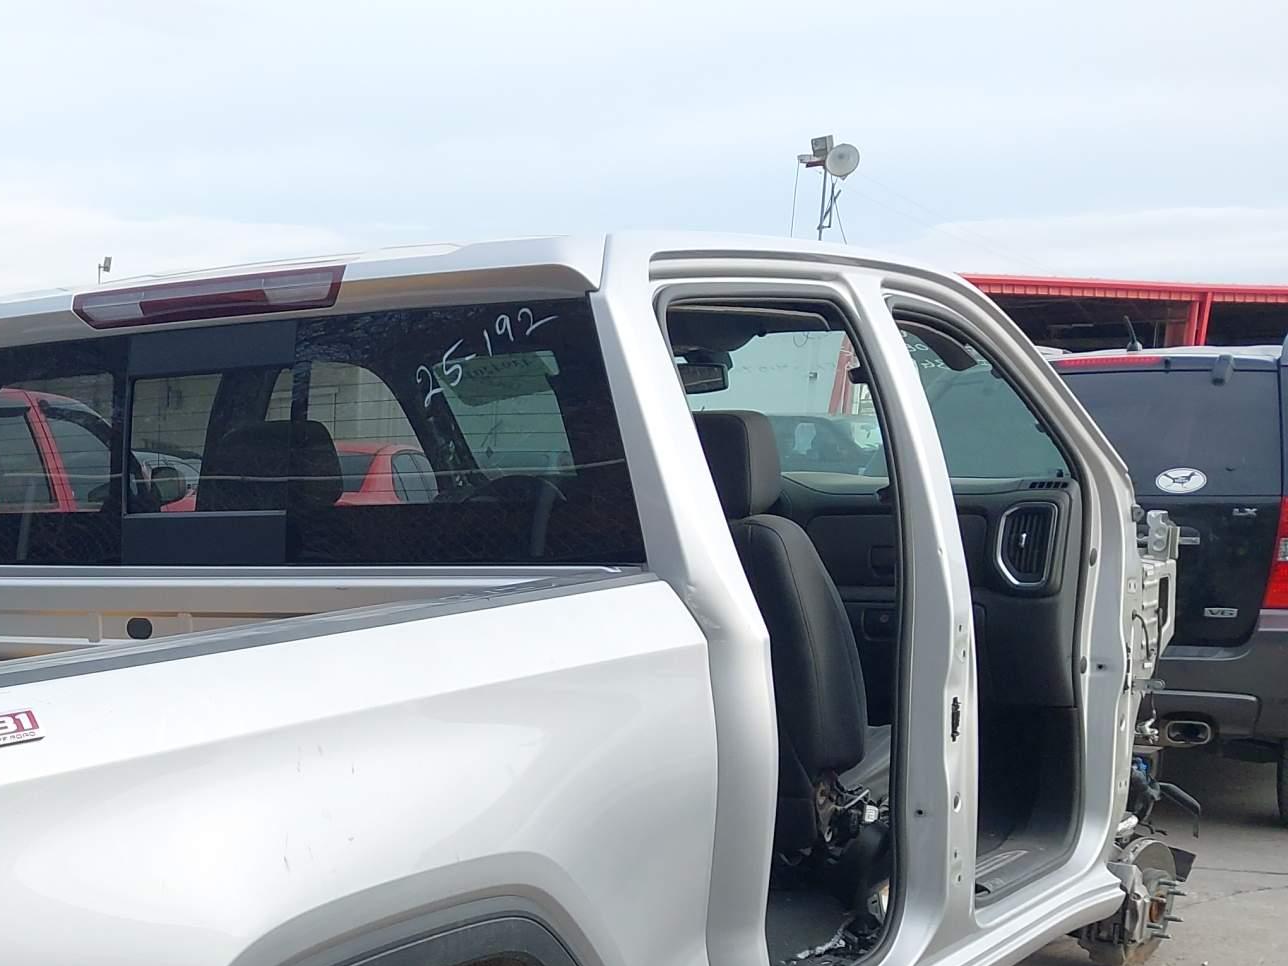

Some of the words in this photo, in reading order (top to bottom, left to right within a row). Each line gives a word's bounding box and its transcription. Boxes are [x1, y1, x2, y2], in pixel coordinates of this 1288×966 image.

[416, 307, 559, 408] 25-192
[1232, 508, 1258, 516] LX
[1206, 609, 1237, 617] V6
